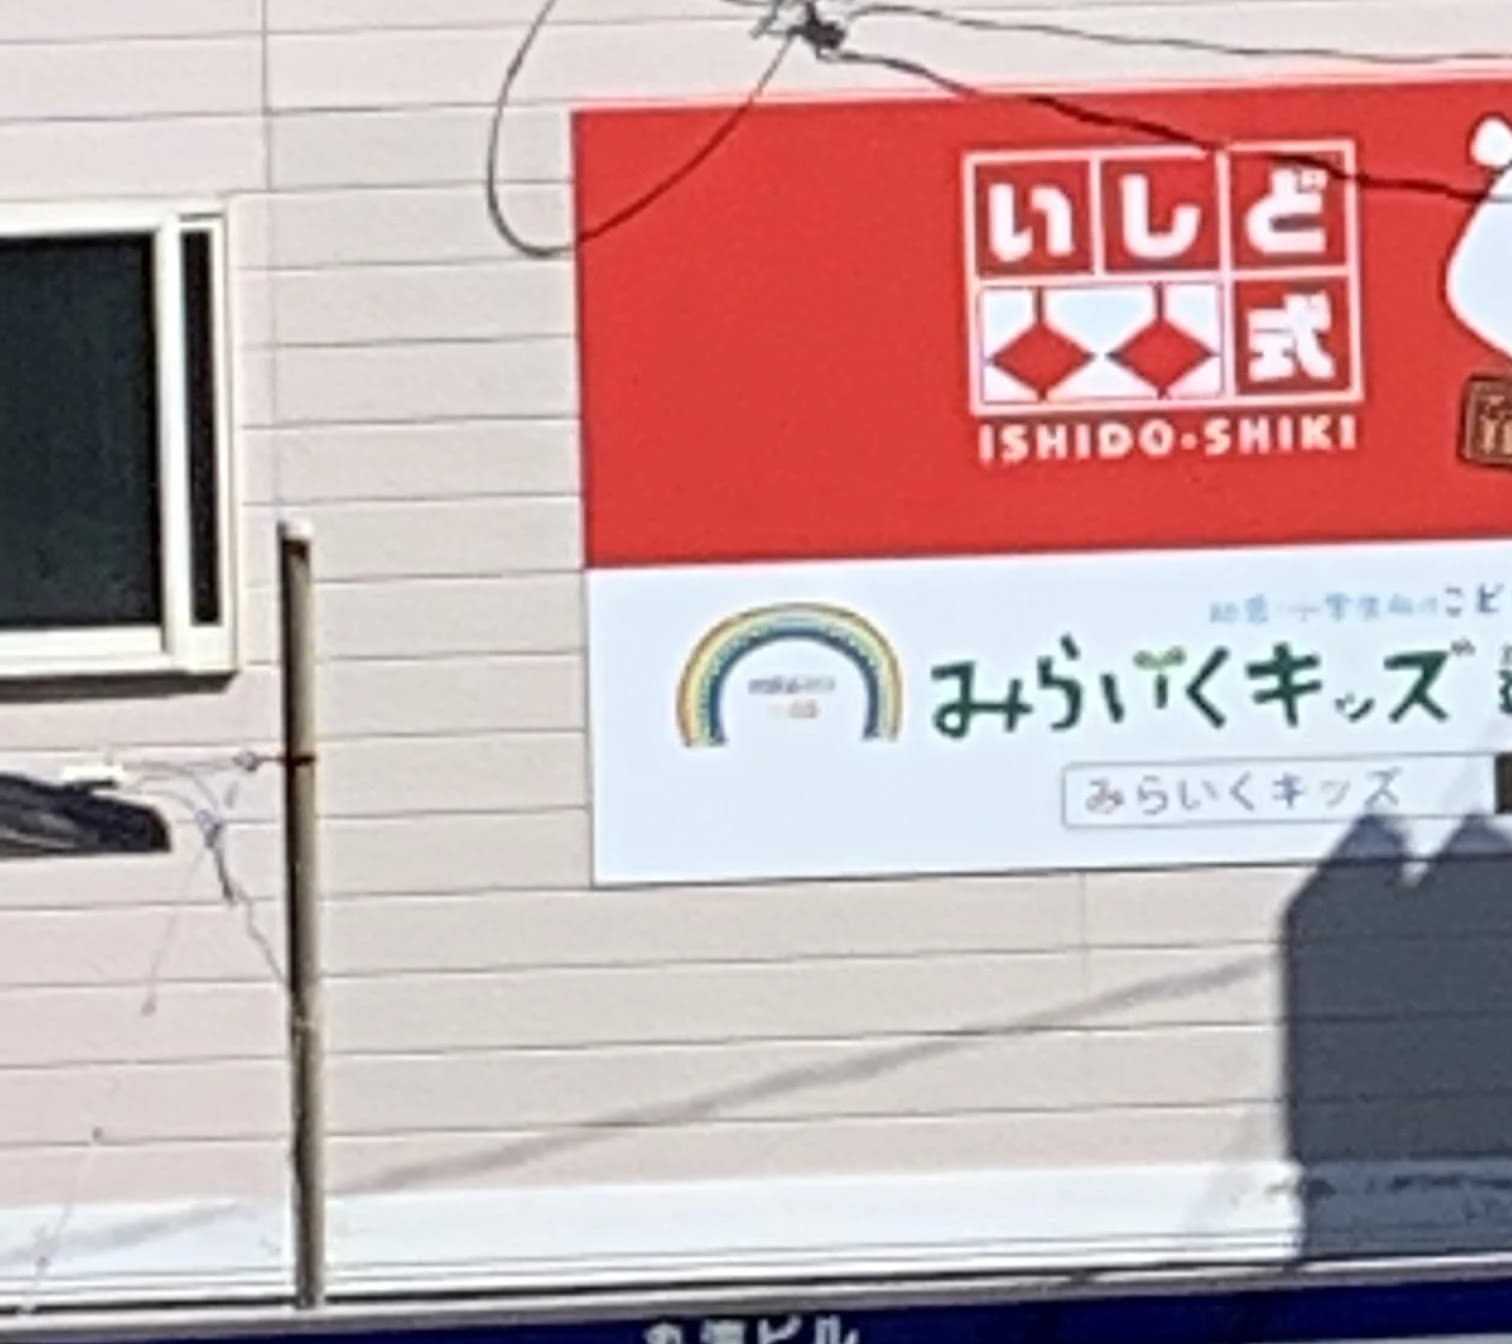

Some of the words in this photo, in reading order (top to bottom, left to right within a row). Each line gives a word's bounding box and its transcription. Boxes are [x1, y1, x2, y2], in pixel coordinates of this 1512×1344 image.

[986, 165, 1329, 263] いしど
[1247, 291, 1337, 382] 式
[930, 632, 1476, 739] みらいくキッズ
[1084, 766, 1403, 817] みらいくキッズ
